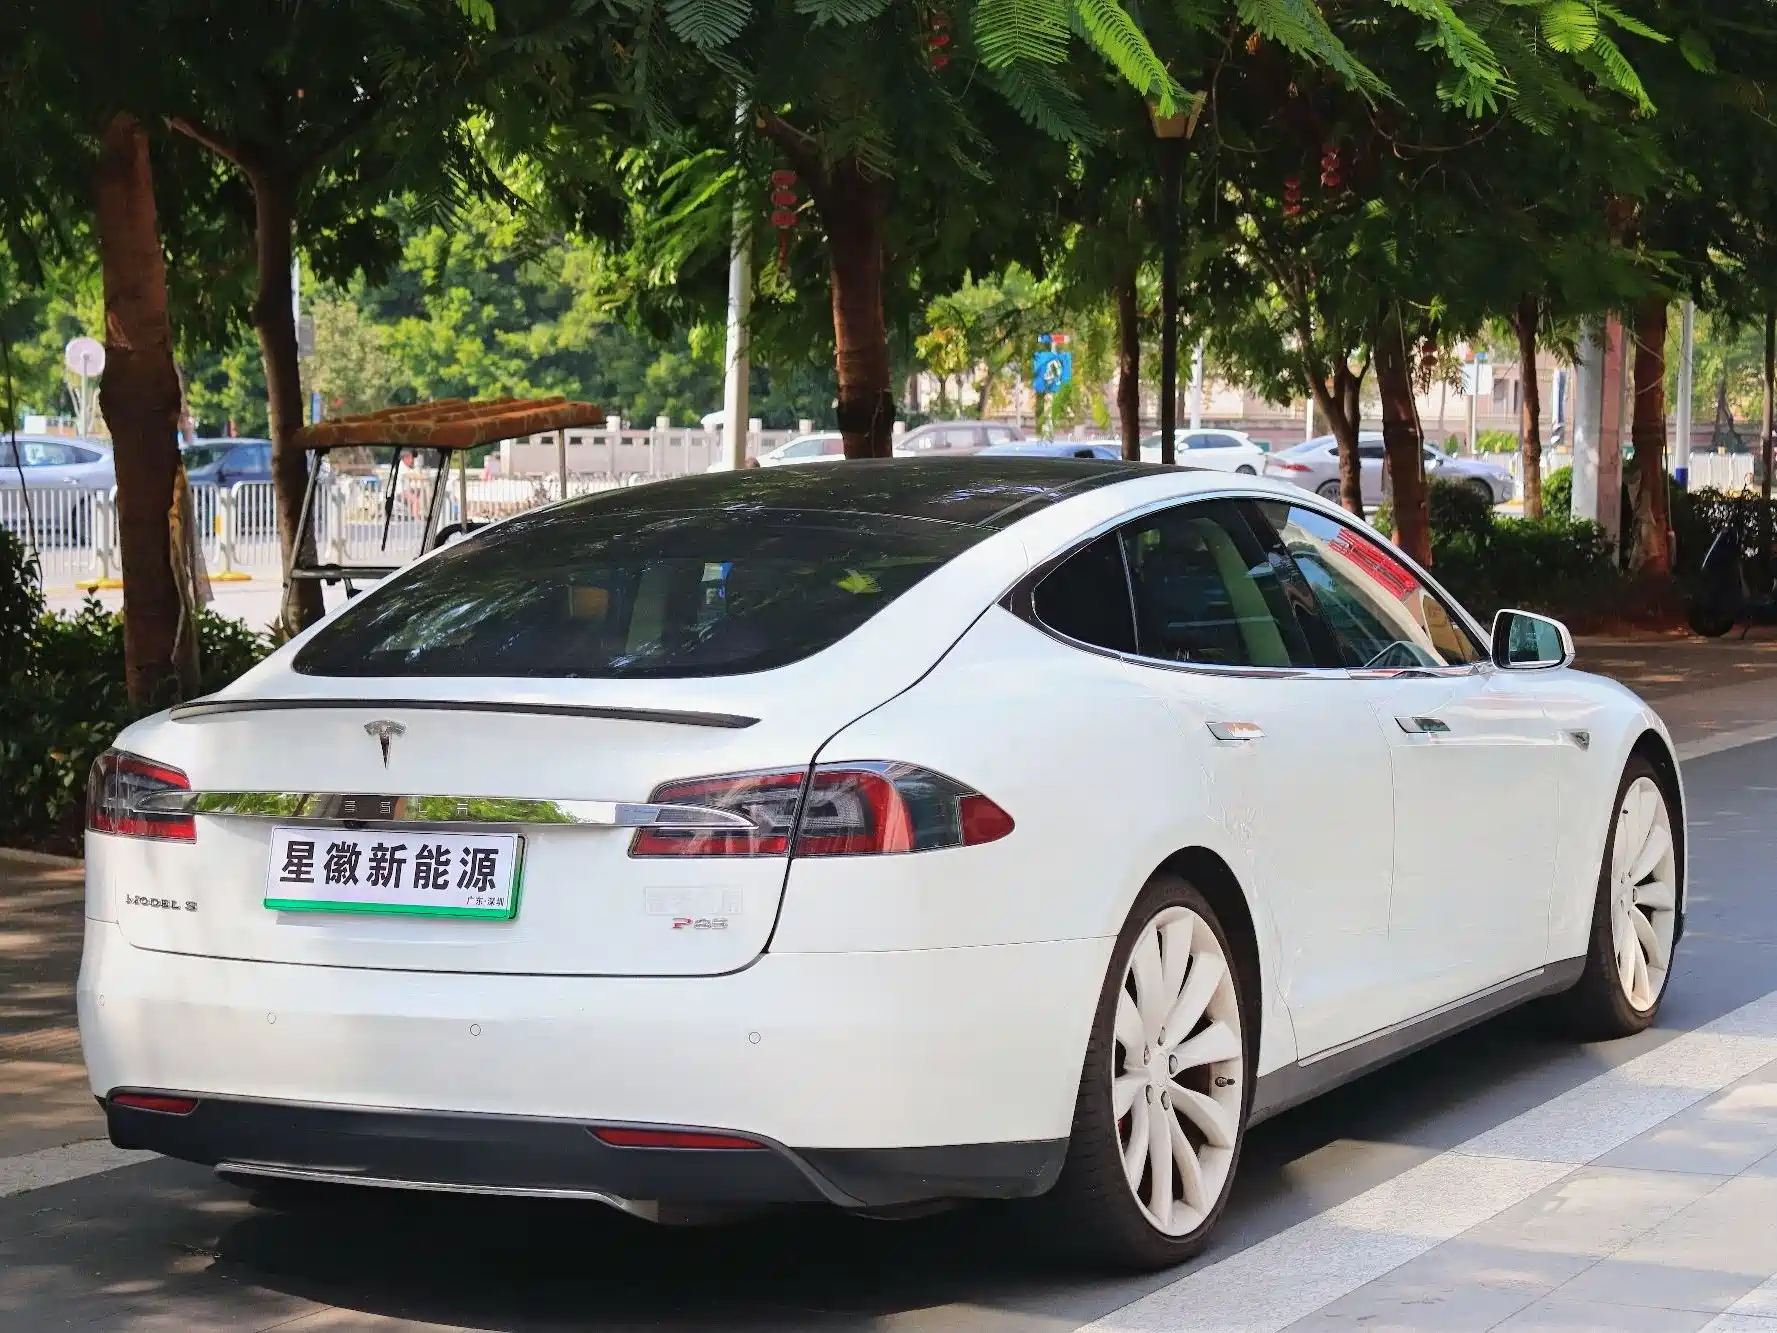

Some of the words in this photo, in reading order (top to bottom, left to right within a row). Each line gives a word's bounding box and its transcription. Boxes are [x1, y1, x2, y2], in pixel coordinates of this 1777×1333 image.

[279, 841, 500, 892] 星徽新能源
[125, 893, 181, 910] MODEL
[184, 900, 198, 912] S
